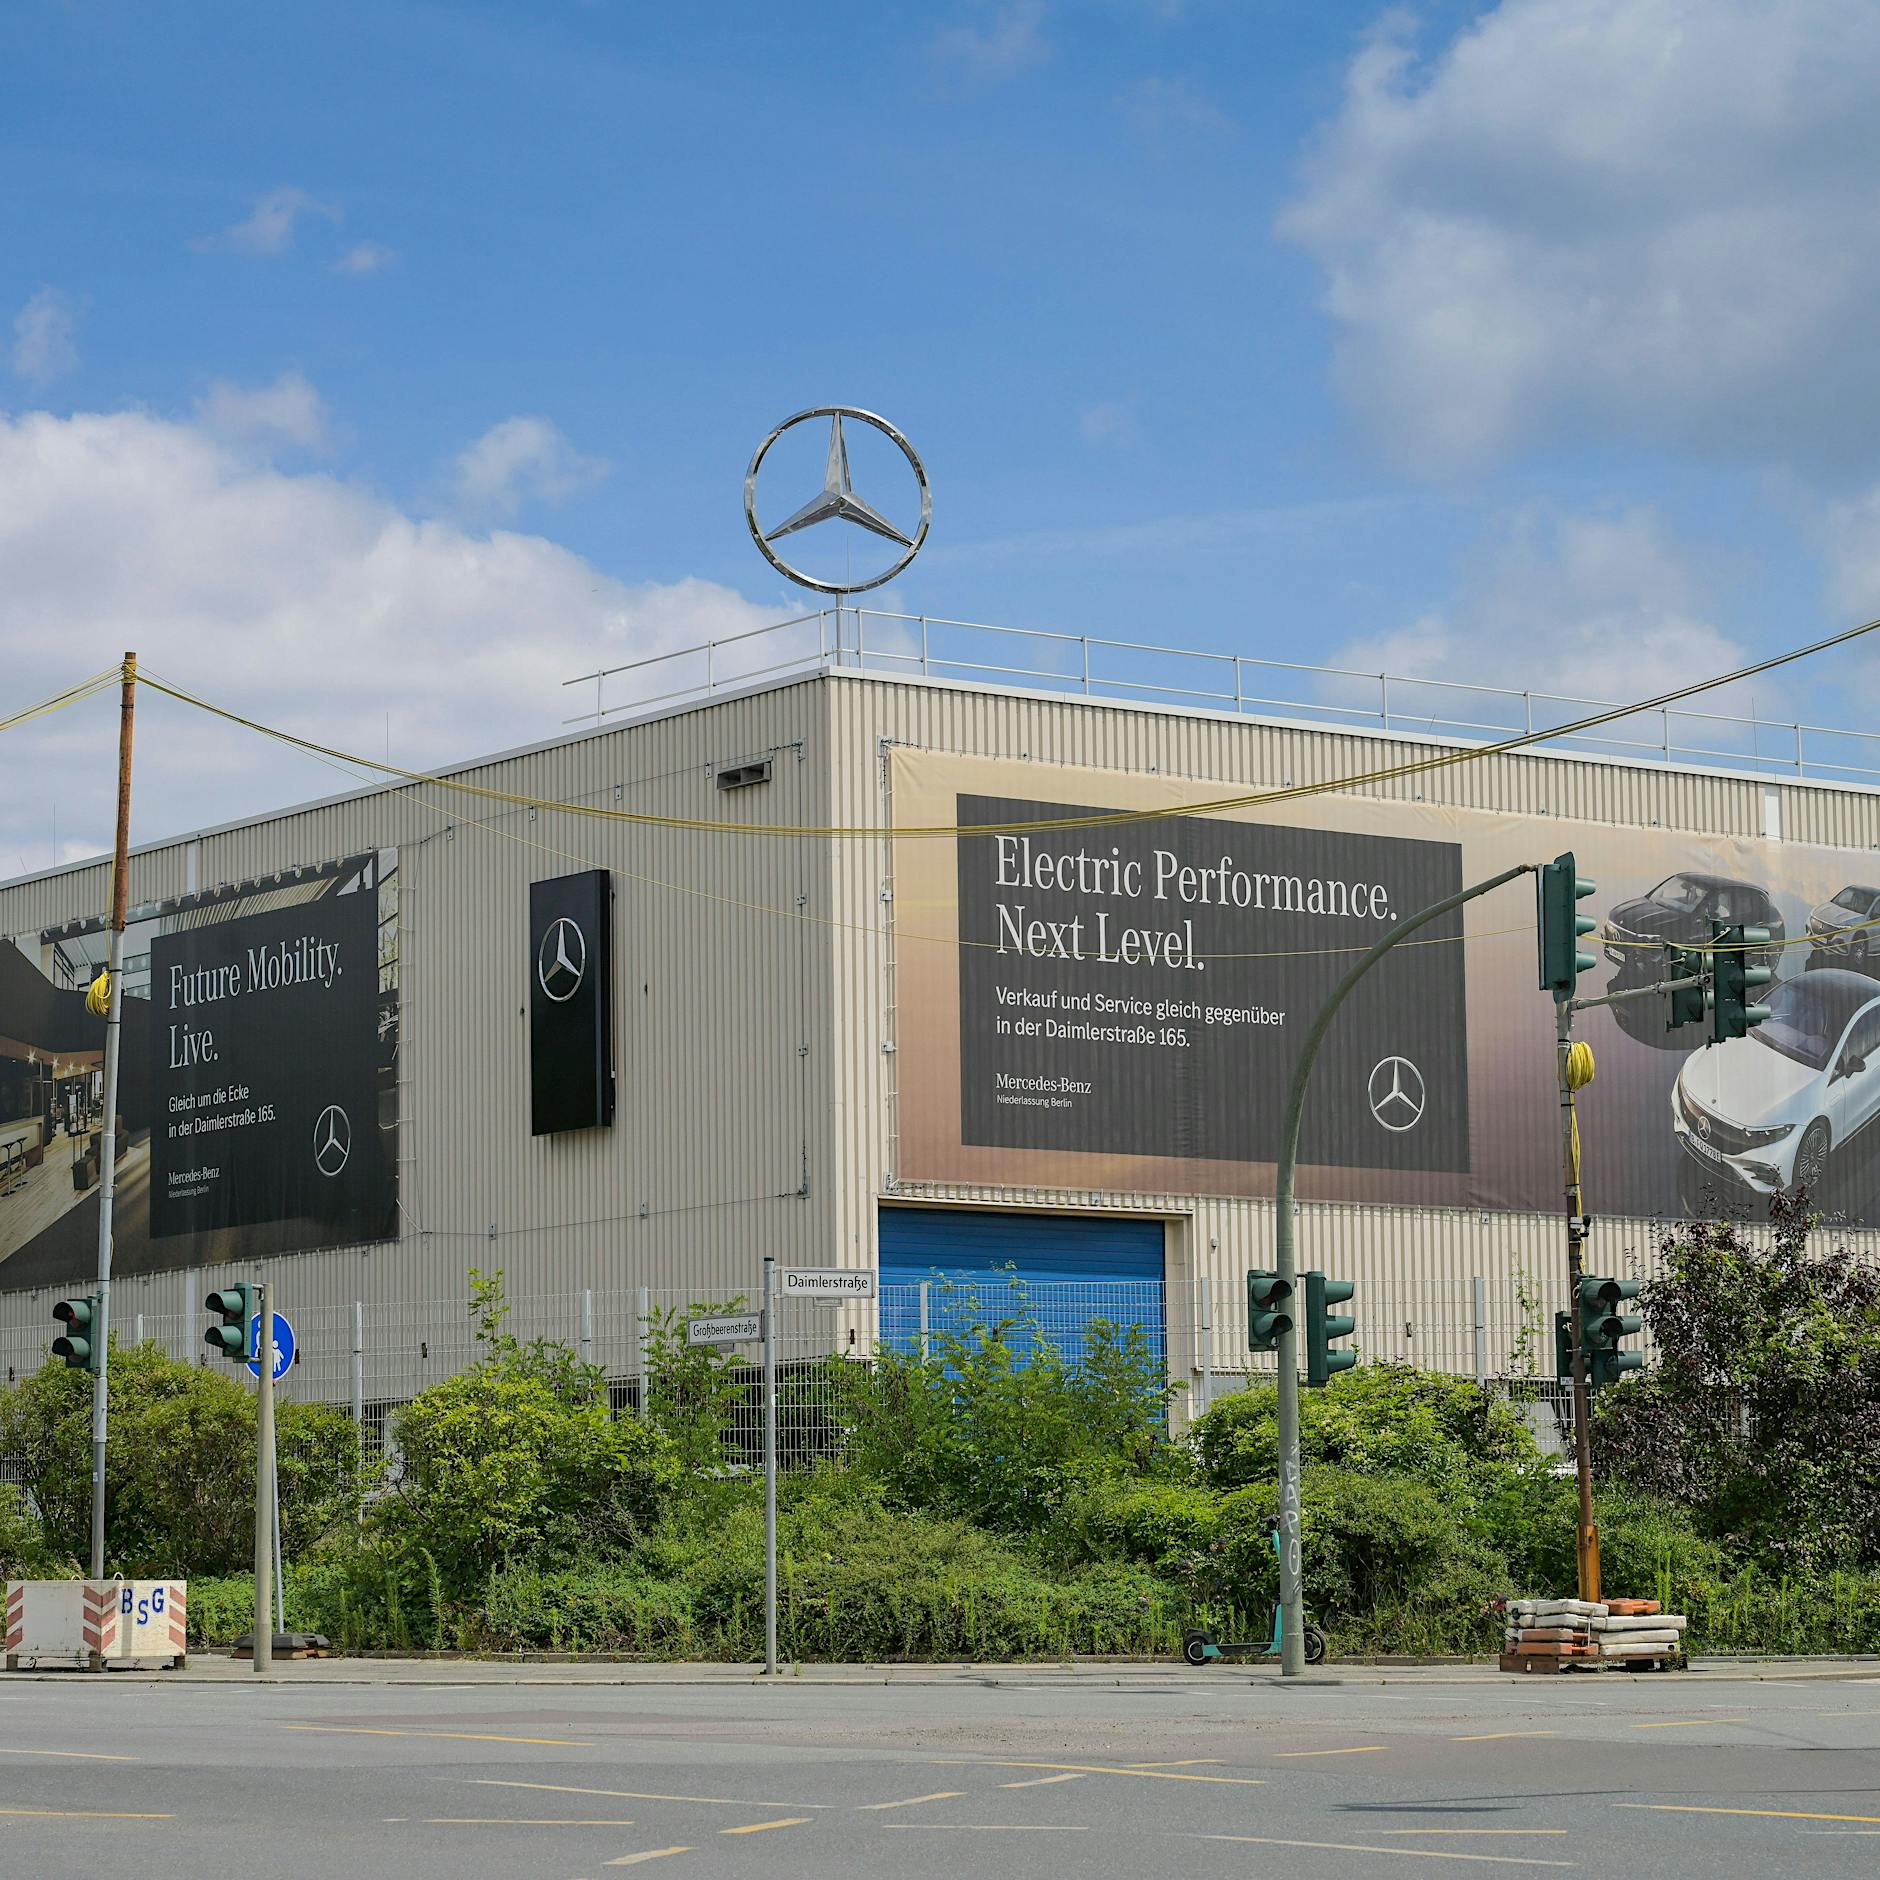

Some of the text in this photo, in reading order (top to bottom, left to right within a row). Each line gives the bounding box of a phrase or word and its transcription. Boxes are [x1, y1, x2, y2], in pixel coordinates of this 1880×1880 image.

[994, 834, 1398, 921] Electric Performance.
[995, 903, 1205, 971] Next Level.
[168, 936, 343, 1010] Future Mobility.
[995, 985, 1286, 1026] Verkauf und Service gleich gegenüber
[169, 1023, 219, 1069] Live.
[996, 1015, 1191, 1048] in der Daimlerstraße 165.
[168, 1083, 250, 1113] Gleich um die Ecke
[996, 1073, 1092, 1094] Mercedes-Benz
[997, 1094, 1073, 1108] Niederlassung Berlin
[168, 1104, 277, 1139] in der Daimlerstraße 165.
[168, 1166, 221, 1186] Mercedes-Benz
[788, 1274, 868, 1292] Daimlerstraße
[693, 1320, 757, 1339] Großbeerenstraße
